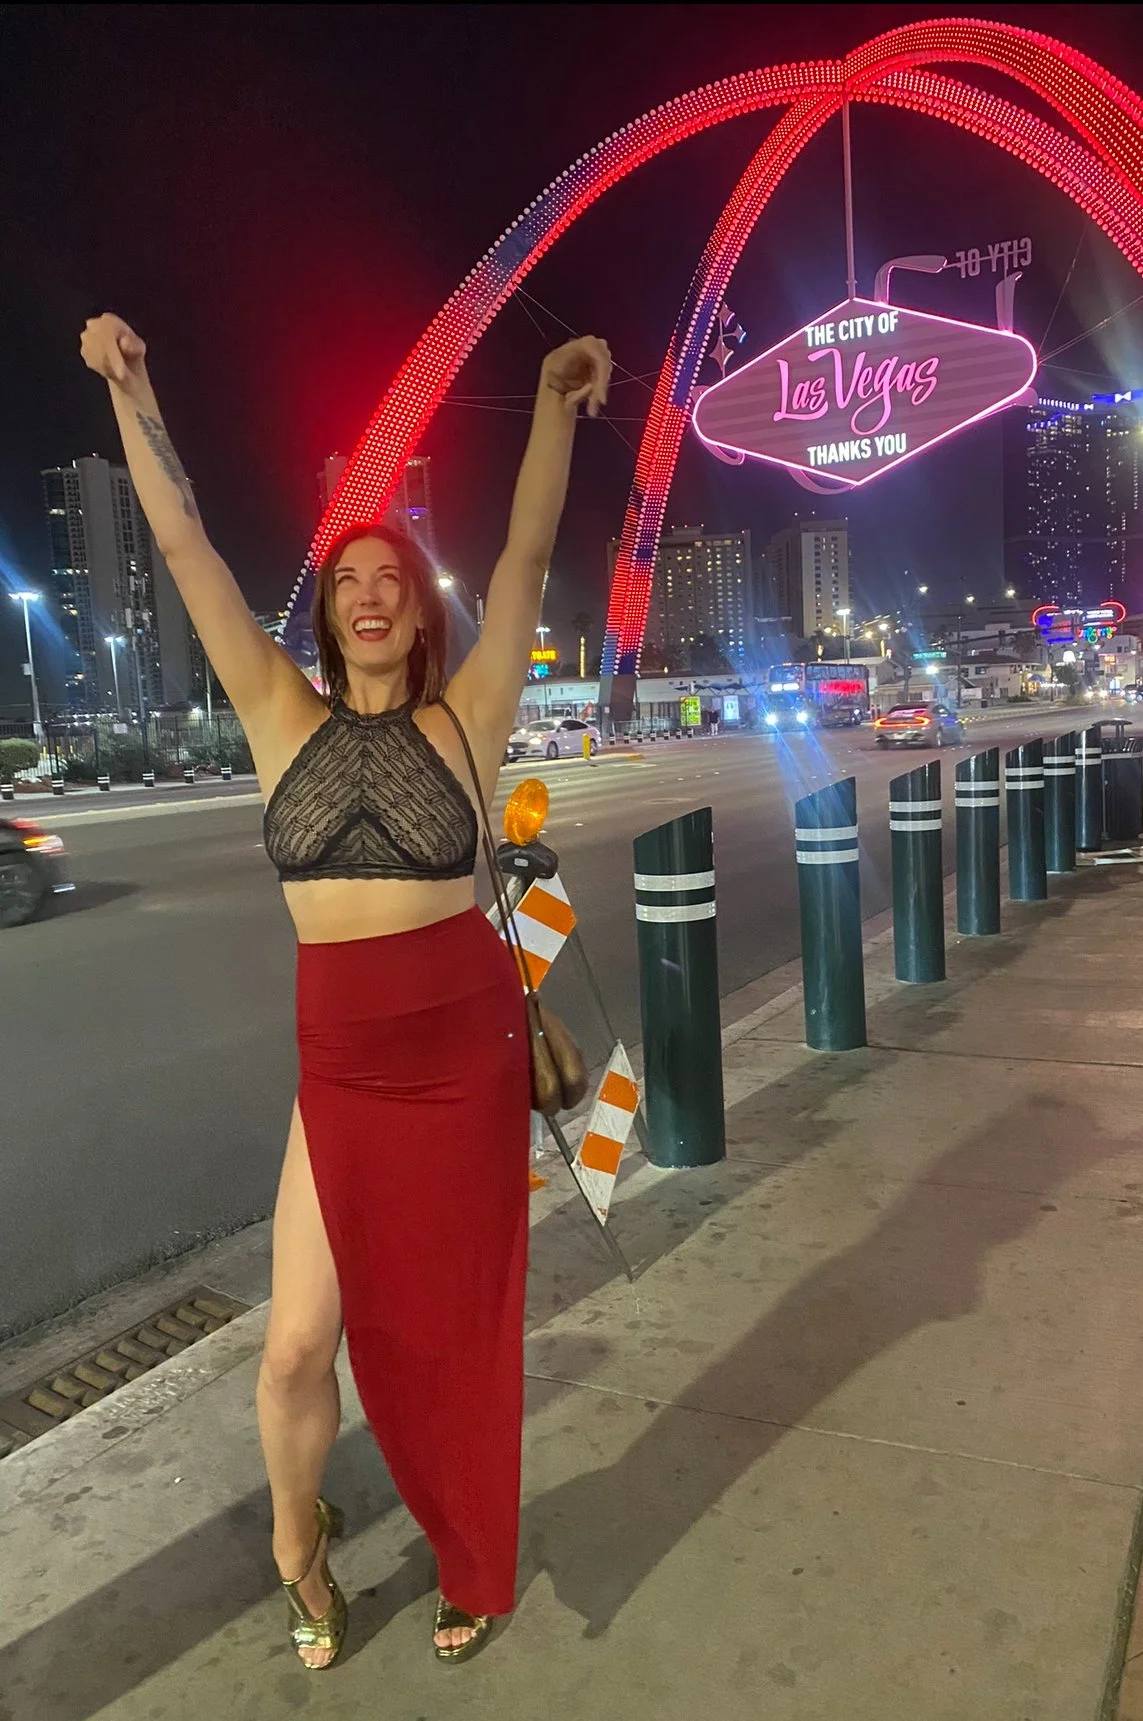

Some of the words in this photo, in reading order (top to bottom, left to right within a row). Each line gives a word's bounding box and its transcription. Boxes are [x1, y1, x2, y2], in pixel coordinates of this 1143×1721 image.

[805, 322, 835, 347] THE
[839, 314, 875, 341] CITY
[877, 310, 899, 334] OF
[773, 359, 829, 422] Las
[808, 348, 940, 435] Vegas
[807, 438, 872, 467] THANKS
[874, 432, 907, 457] YOU
